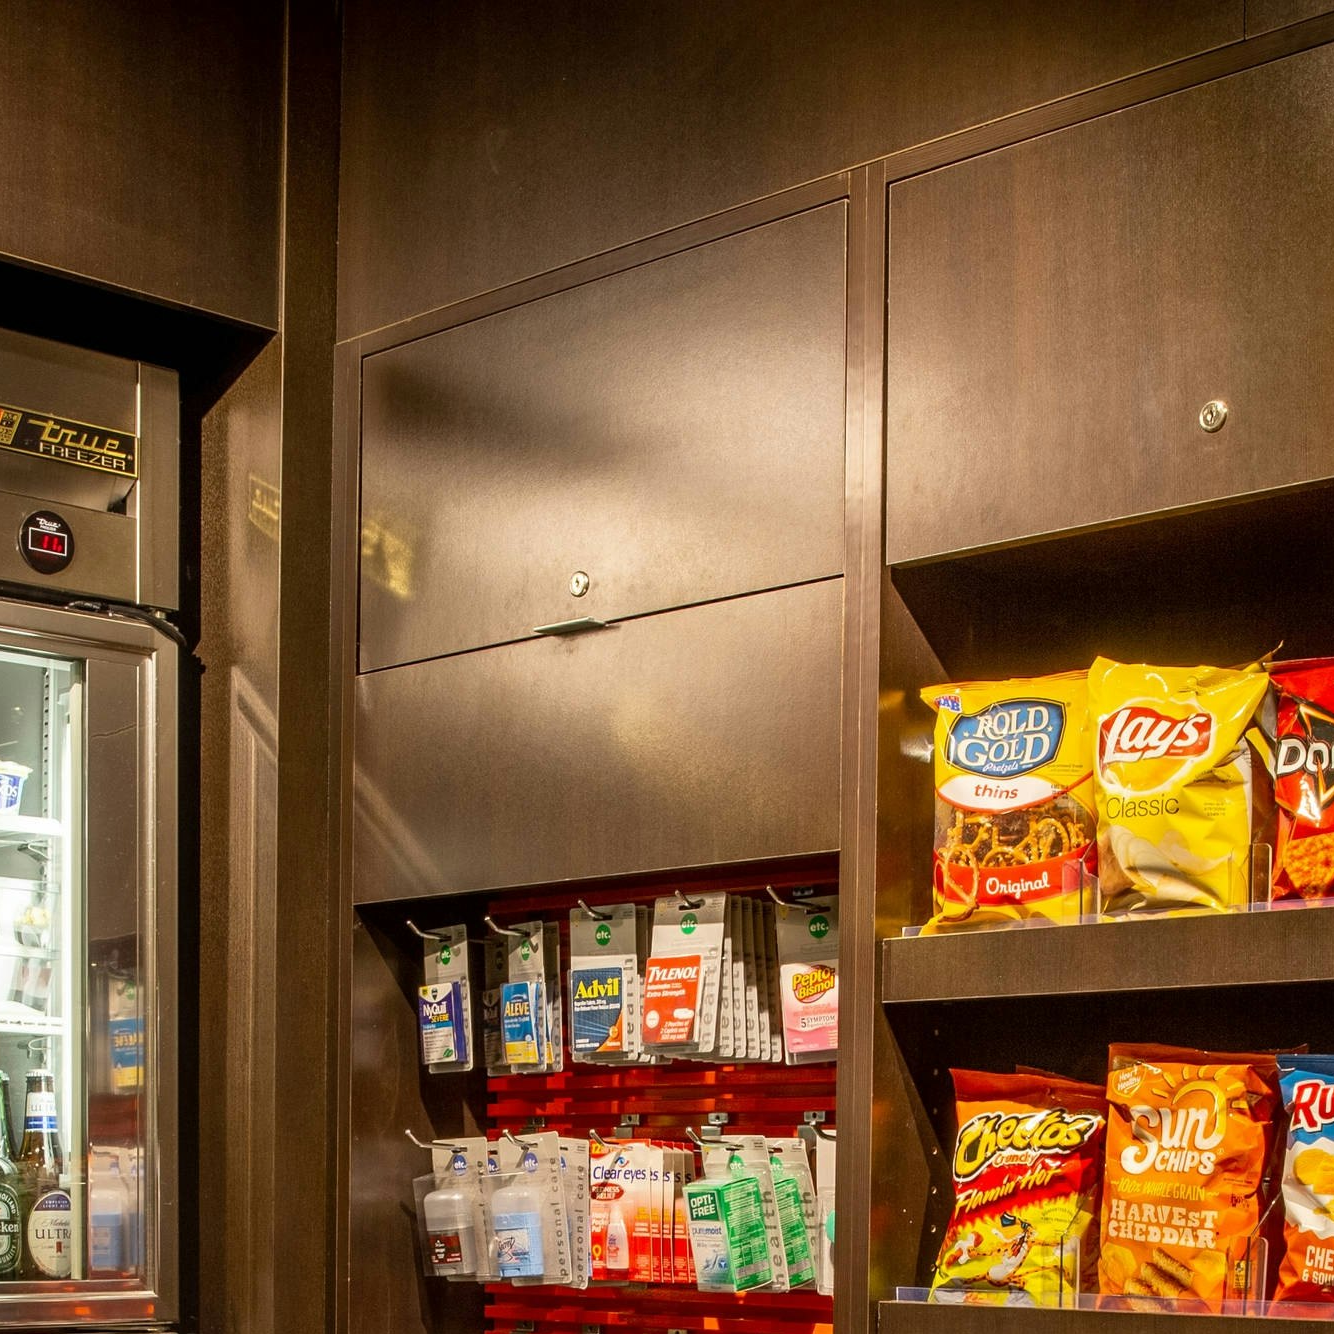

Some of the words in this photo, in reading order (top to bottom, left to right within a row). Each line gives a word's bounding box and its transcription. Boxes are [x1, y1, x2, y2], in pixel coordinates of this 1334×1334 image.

[39, 441, 126, 470] FREEZER
[976, 705, 1049, 738] ROLD
[1104, 708, 1209, 764] Lay's
[957, 733, 1051, 766] GOLD
[983, 761, 1020, 772] Pretzels
[974, 784, 1019, 800] thins
[1106, 794, 1180, 819] Classic
[985, 872, 1051, 899] Original
[648, 966, 699, 983] TYLENOL
[574, 977, 620, 1000] Advil
[797, 978, 834, 1000] Bismol
[423, 1001, 447, 1019] NyQuil
[431, 1014, 449, 1023] SEVERE
[504, 1002, 529, 1016] ALEVE
[1117, 1076, 1141, 1092] Healthy
[954, 1110, 1097, 1177] Cheetos
[1121, 1104, 1227, 1175] Sun
[993, 1152, 1039, 1166] Crunchy
[1155, 1150, 1216, 1175] CHIPS
[550, 1157, 558, 1193] care
[593, 1166, 622, 1180] Clear
[623, 1168, 646, 1184] eyes
[1142, 1181, 1172, 1198] WHOLE
[1173, 1183, 1205, 1200] GRAIN
[692, 1205, 716, 1218] FREE
[1109, 1199, 1218, 1227] HARVEST
[550, 1202, 569, 1277] personal
[1108, 1220, 1216, 1248] CHEDDAR
